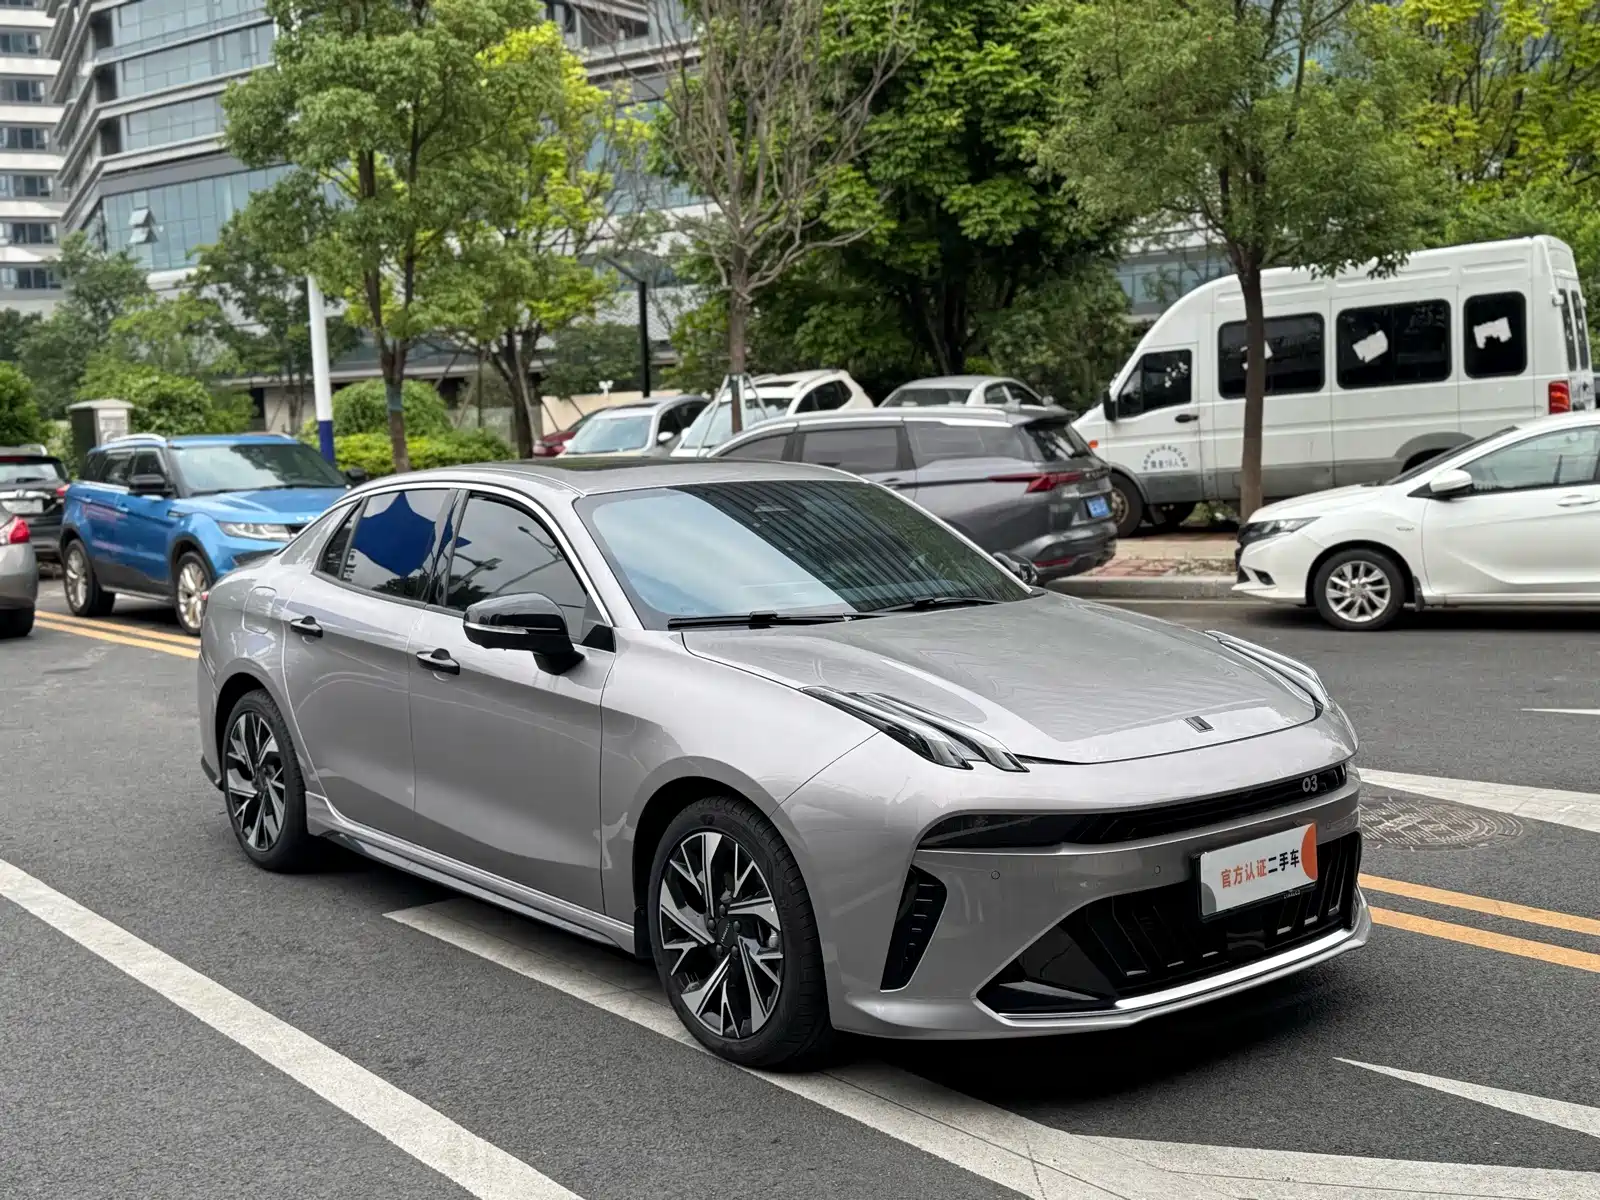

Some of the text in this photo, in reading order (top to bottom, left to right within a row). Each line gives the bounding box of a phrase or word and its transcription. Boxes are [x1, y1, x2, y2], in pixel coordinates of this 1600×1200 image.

[1302, 774, 1318, 792] 03
[1220, 848, 1300, 889] 官方认证二手车
